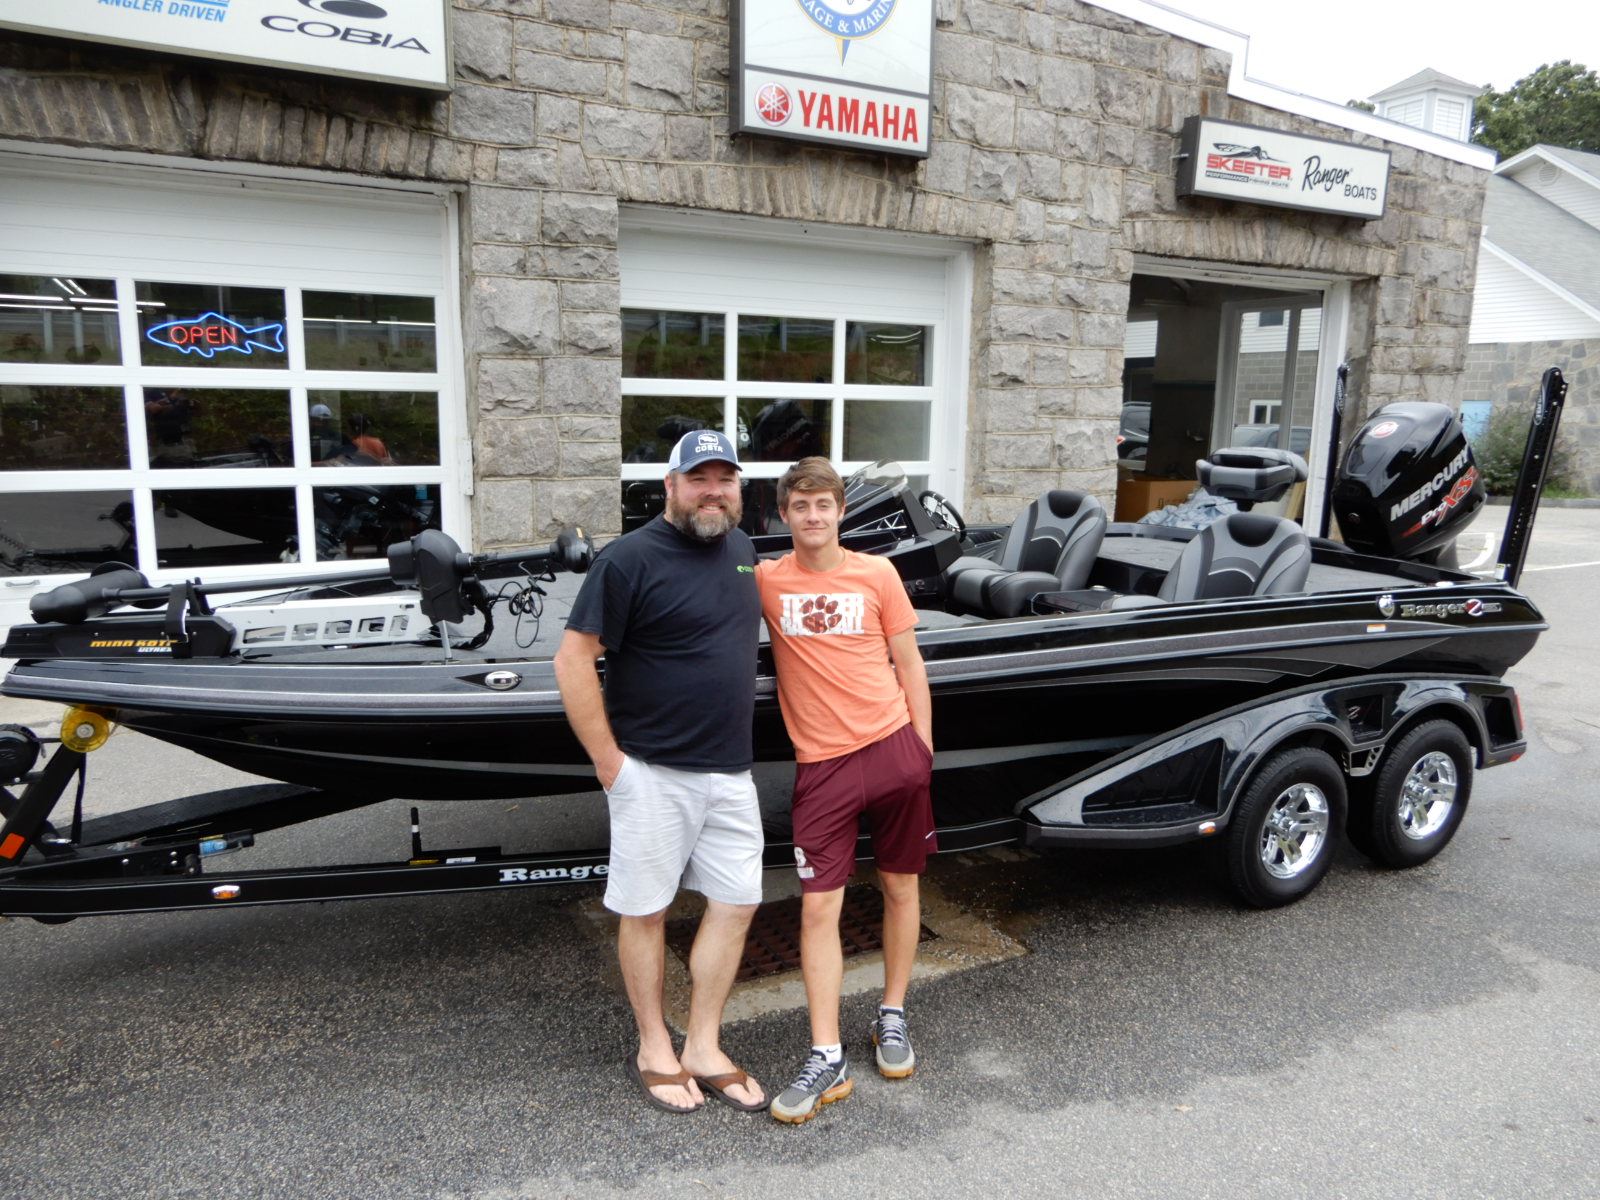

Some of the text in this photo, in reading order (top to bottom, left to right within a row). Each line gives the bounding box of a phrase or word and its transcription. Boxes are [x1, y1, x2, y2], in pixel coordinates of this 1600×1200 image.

[168, 2, 226, 22] DRIVEN
[803, 0, 834, 28] AGE
[837, 19, 850, 33] &
[260, 15, 431, 54] COBIA
[798, 90, 919, 143] YAMAHA
[1206, 153, 1292, 180] SKEETER
[1302, 155, 1350, 192] Ranger
[1344, 184, 1377, 200] BOATS
[170, 326, 237, 344] OPEN
[695, 445, 723, 453] COSTA
[1390, 443, 1469, 522] MERCURY
[1401, 602, 1466, 618] Ranger
